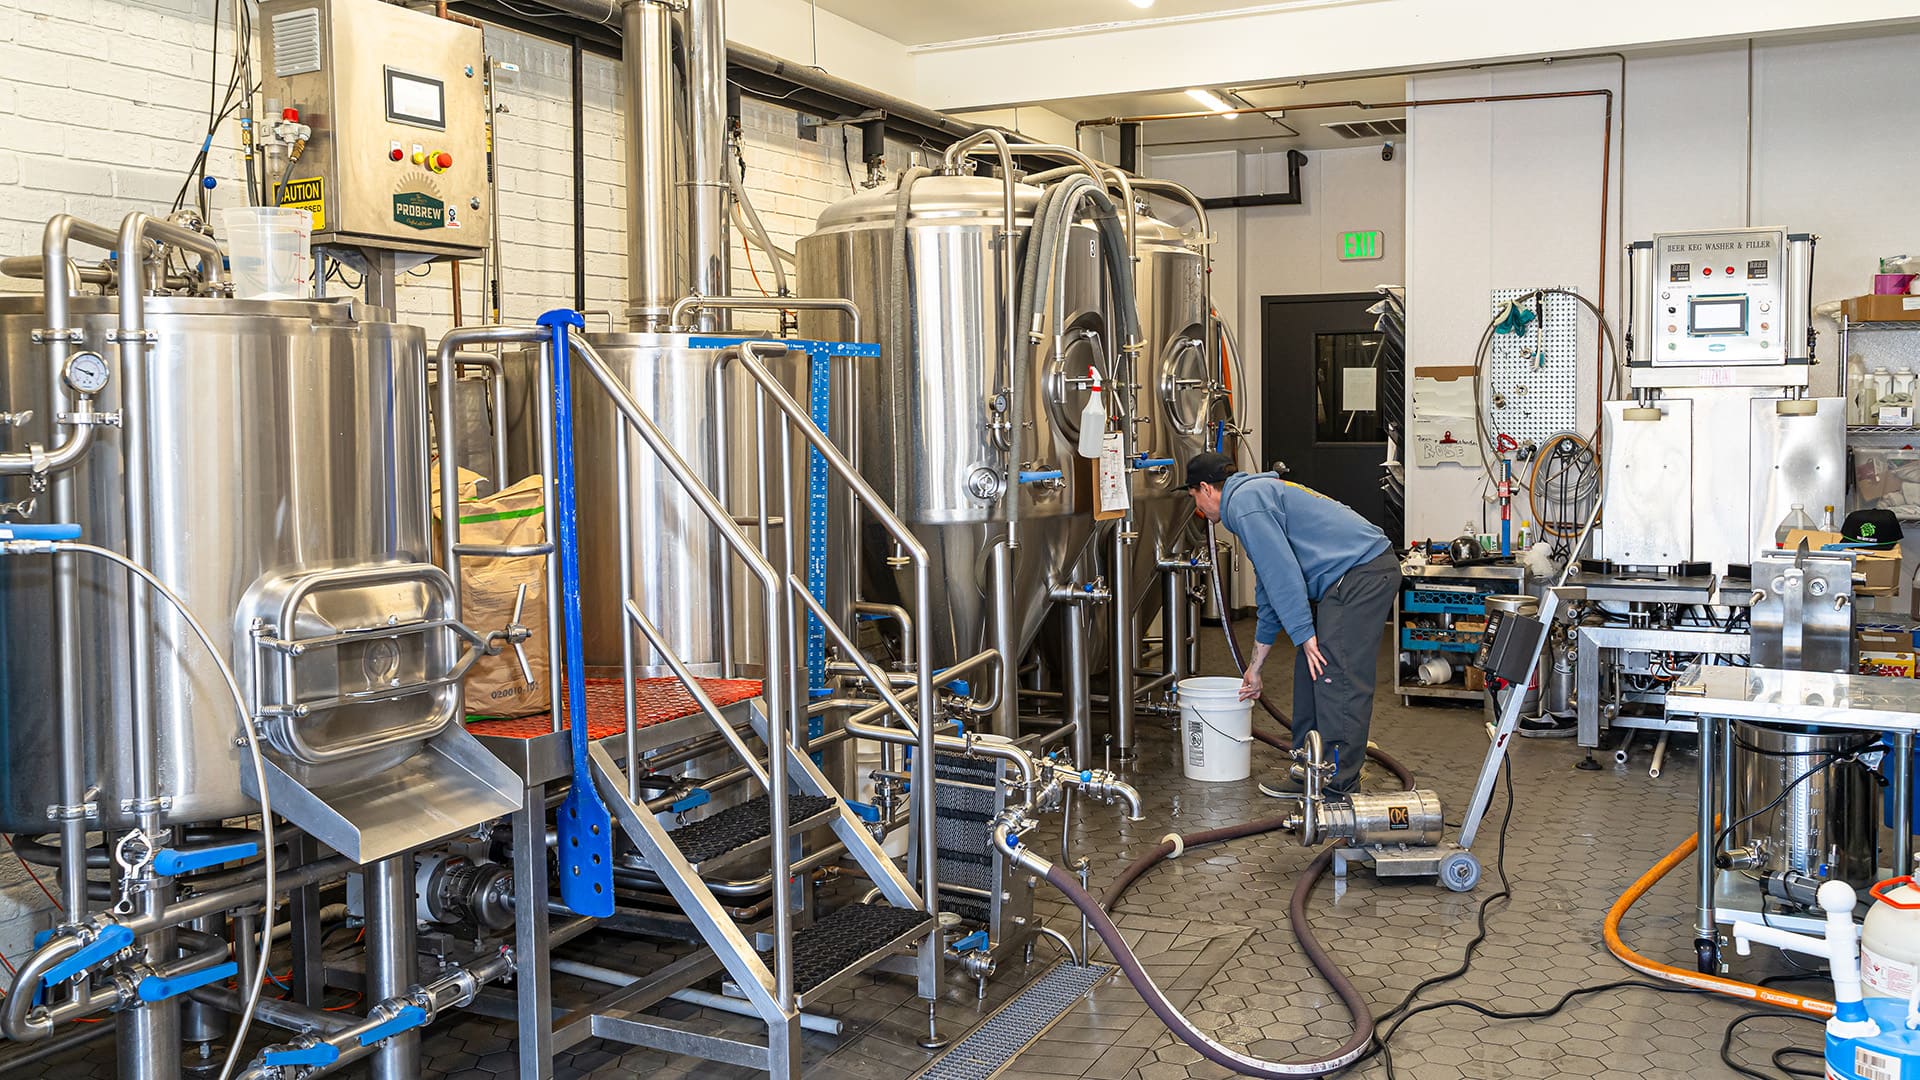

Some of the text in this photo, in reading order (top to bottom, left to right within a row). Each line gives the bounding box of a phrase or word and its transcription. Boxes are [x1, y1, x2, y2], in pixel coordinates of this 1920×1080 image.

[396, 203, 441, 220] PROBREW
[1344, 231, 1377, 258] EXIT
[1667, 240, 1771, 253] BEER KEG WASHER & FILLER
